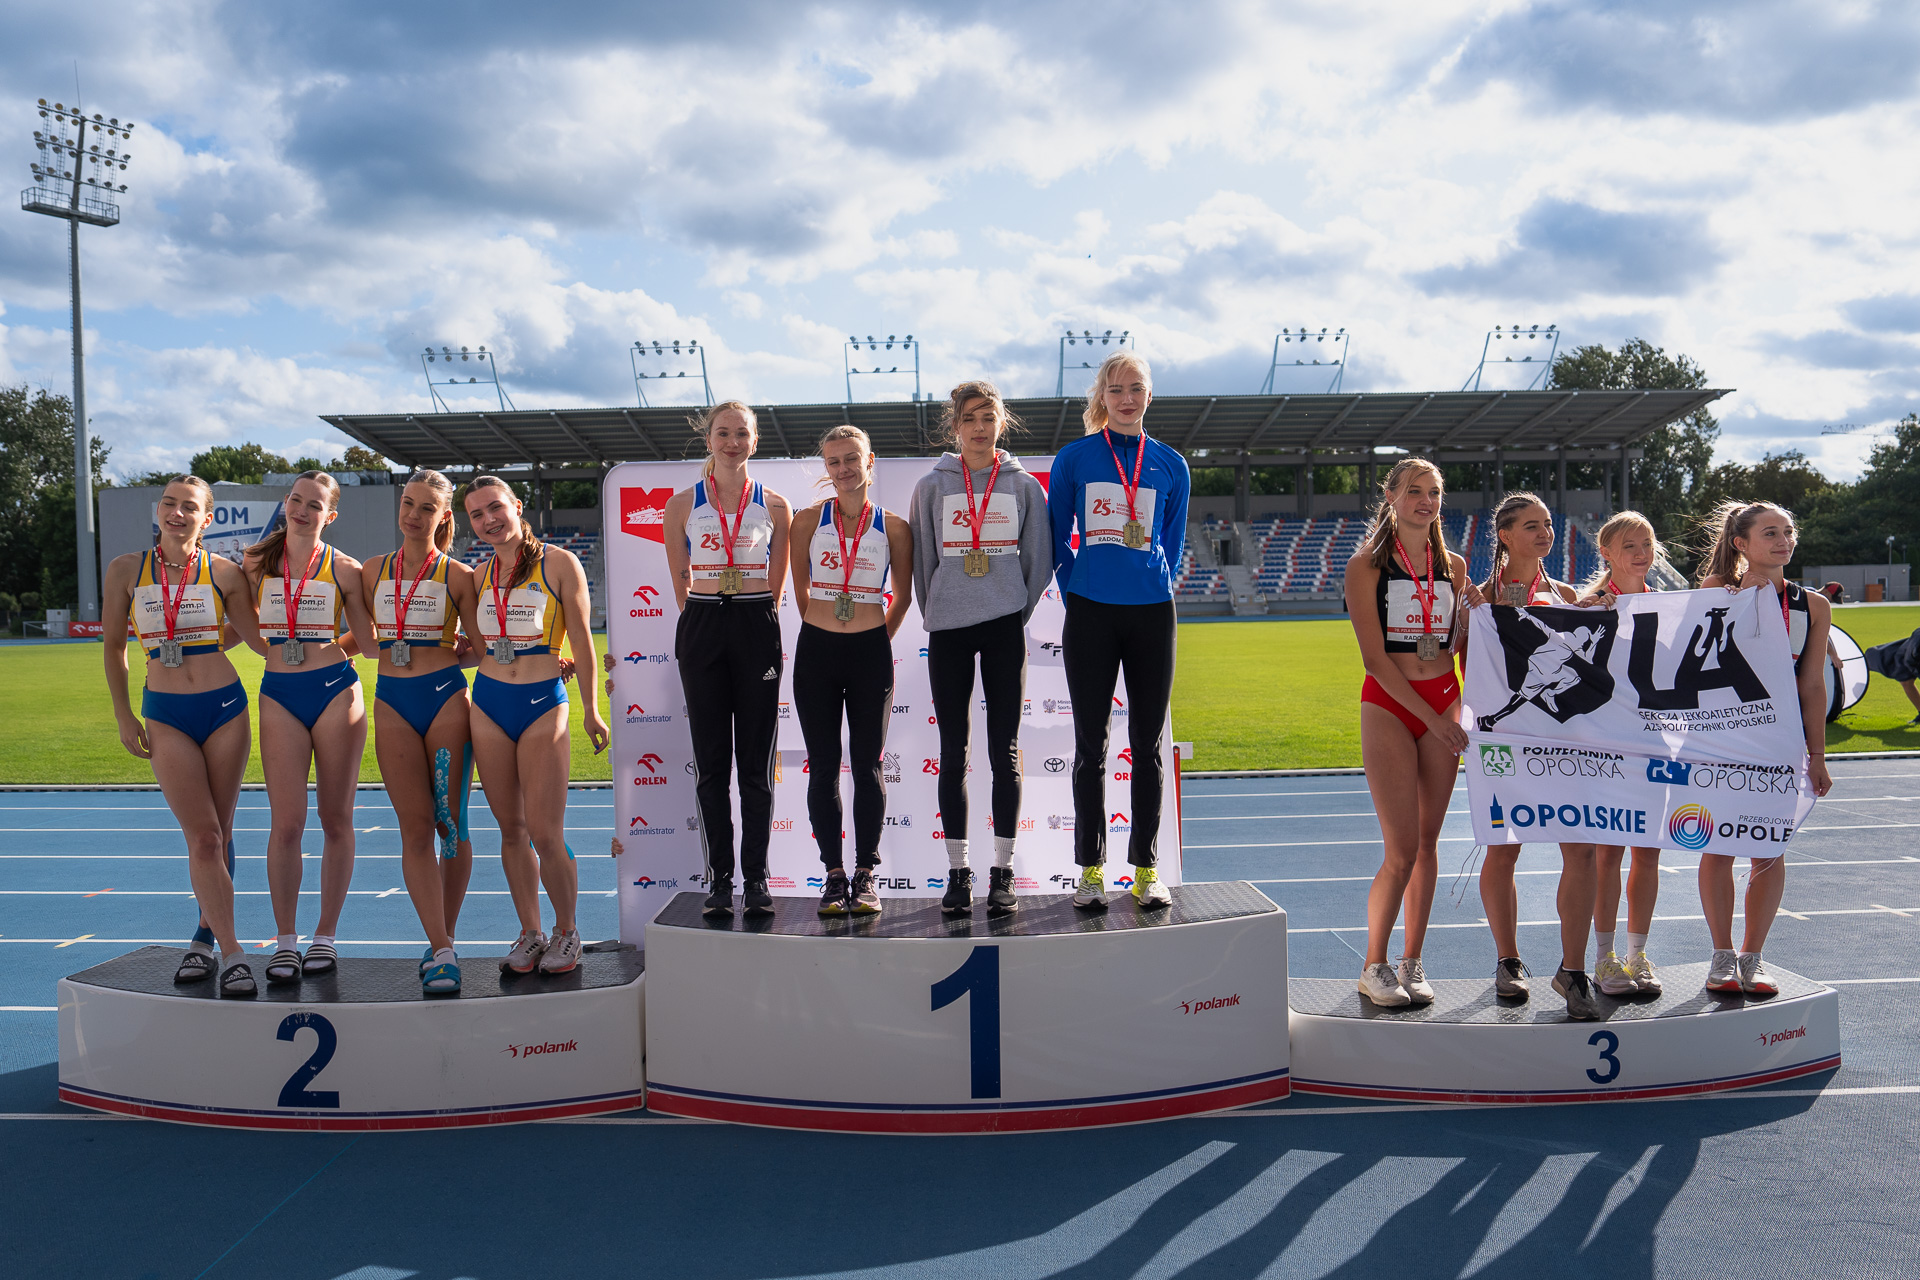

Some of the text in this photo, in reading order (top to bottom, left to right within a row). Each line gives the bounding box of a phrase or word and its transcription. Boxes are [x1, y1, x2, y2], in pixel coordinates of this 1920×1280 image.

[630, 608, 663, 617] ORLEN
[1406, 615, 1442, 624] OREN
[650, 653, 669, 664] mpk
[626, 715, 672, 723] administrator
[1639, 702, 1774, 721] SEKCJA LEKKOATLETYCZNA
[1662, 722, 1725, 732] POLITECHNIKI
[1728, 714, 1776, 730] OPOLSKIEJ
[1522, 747, 1624, 761] POLITECHNIKA
[1527, 758, 1625, 779] OPOLSKA
[634, 777, 667, 785] ORLEN
[1694, 768, 1799, 795] OPOLSKA
[772, 818, 793, 830] osir
[1511, 804, 1646, 833] OPOLSKIE
[1739, 815, 1795, 826] PRZEBOJOWE
[630, 827, 675, 836] administrator
[1718, 823, 1793, 842] OPOLE
[658, 878, 678, 890] mpk
[878, 878, 916, 889] FUEL
[1193, 993, 1241, 1015] polanik
[931, 945, 1001, 1099] 1
[1770, 1025, 1806, 1046] polanik
[523, 1039, 578, 1058] polanik
[1586, 1030, 1621, 1084] 3
[276, 1012, 340, 1108] 2
